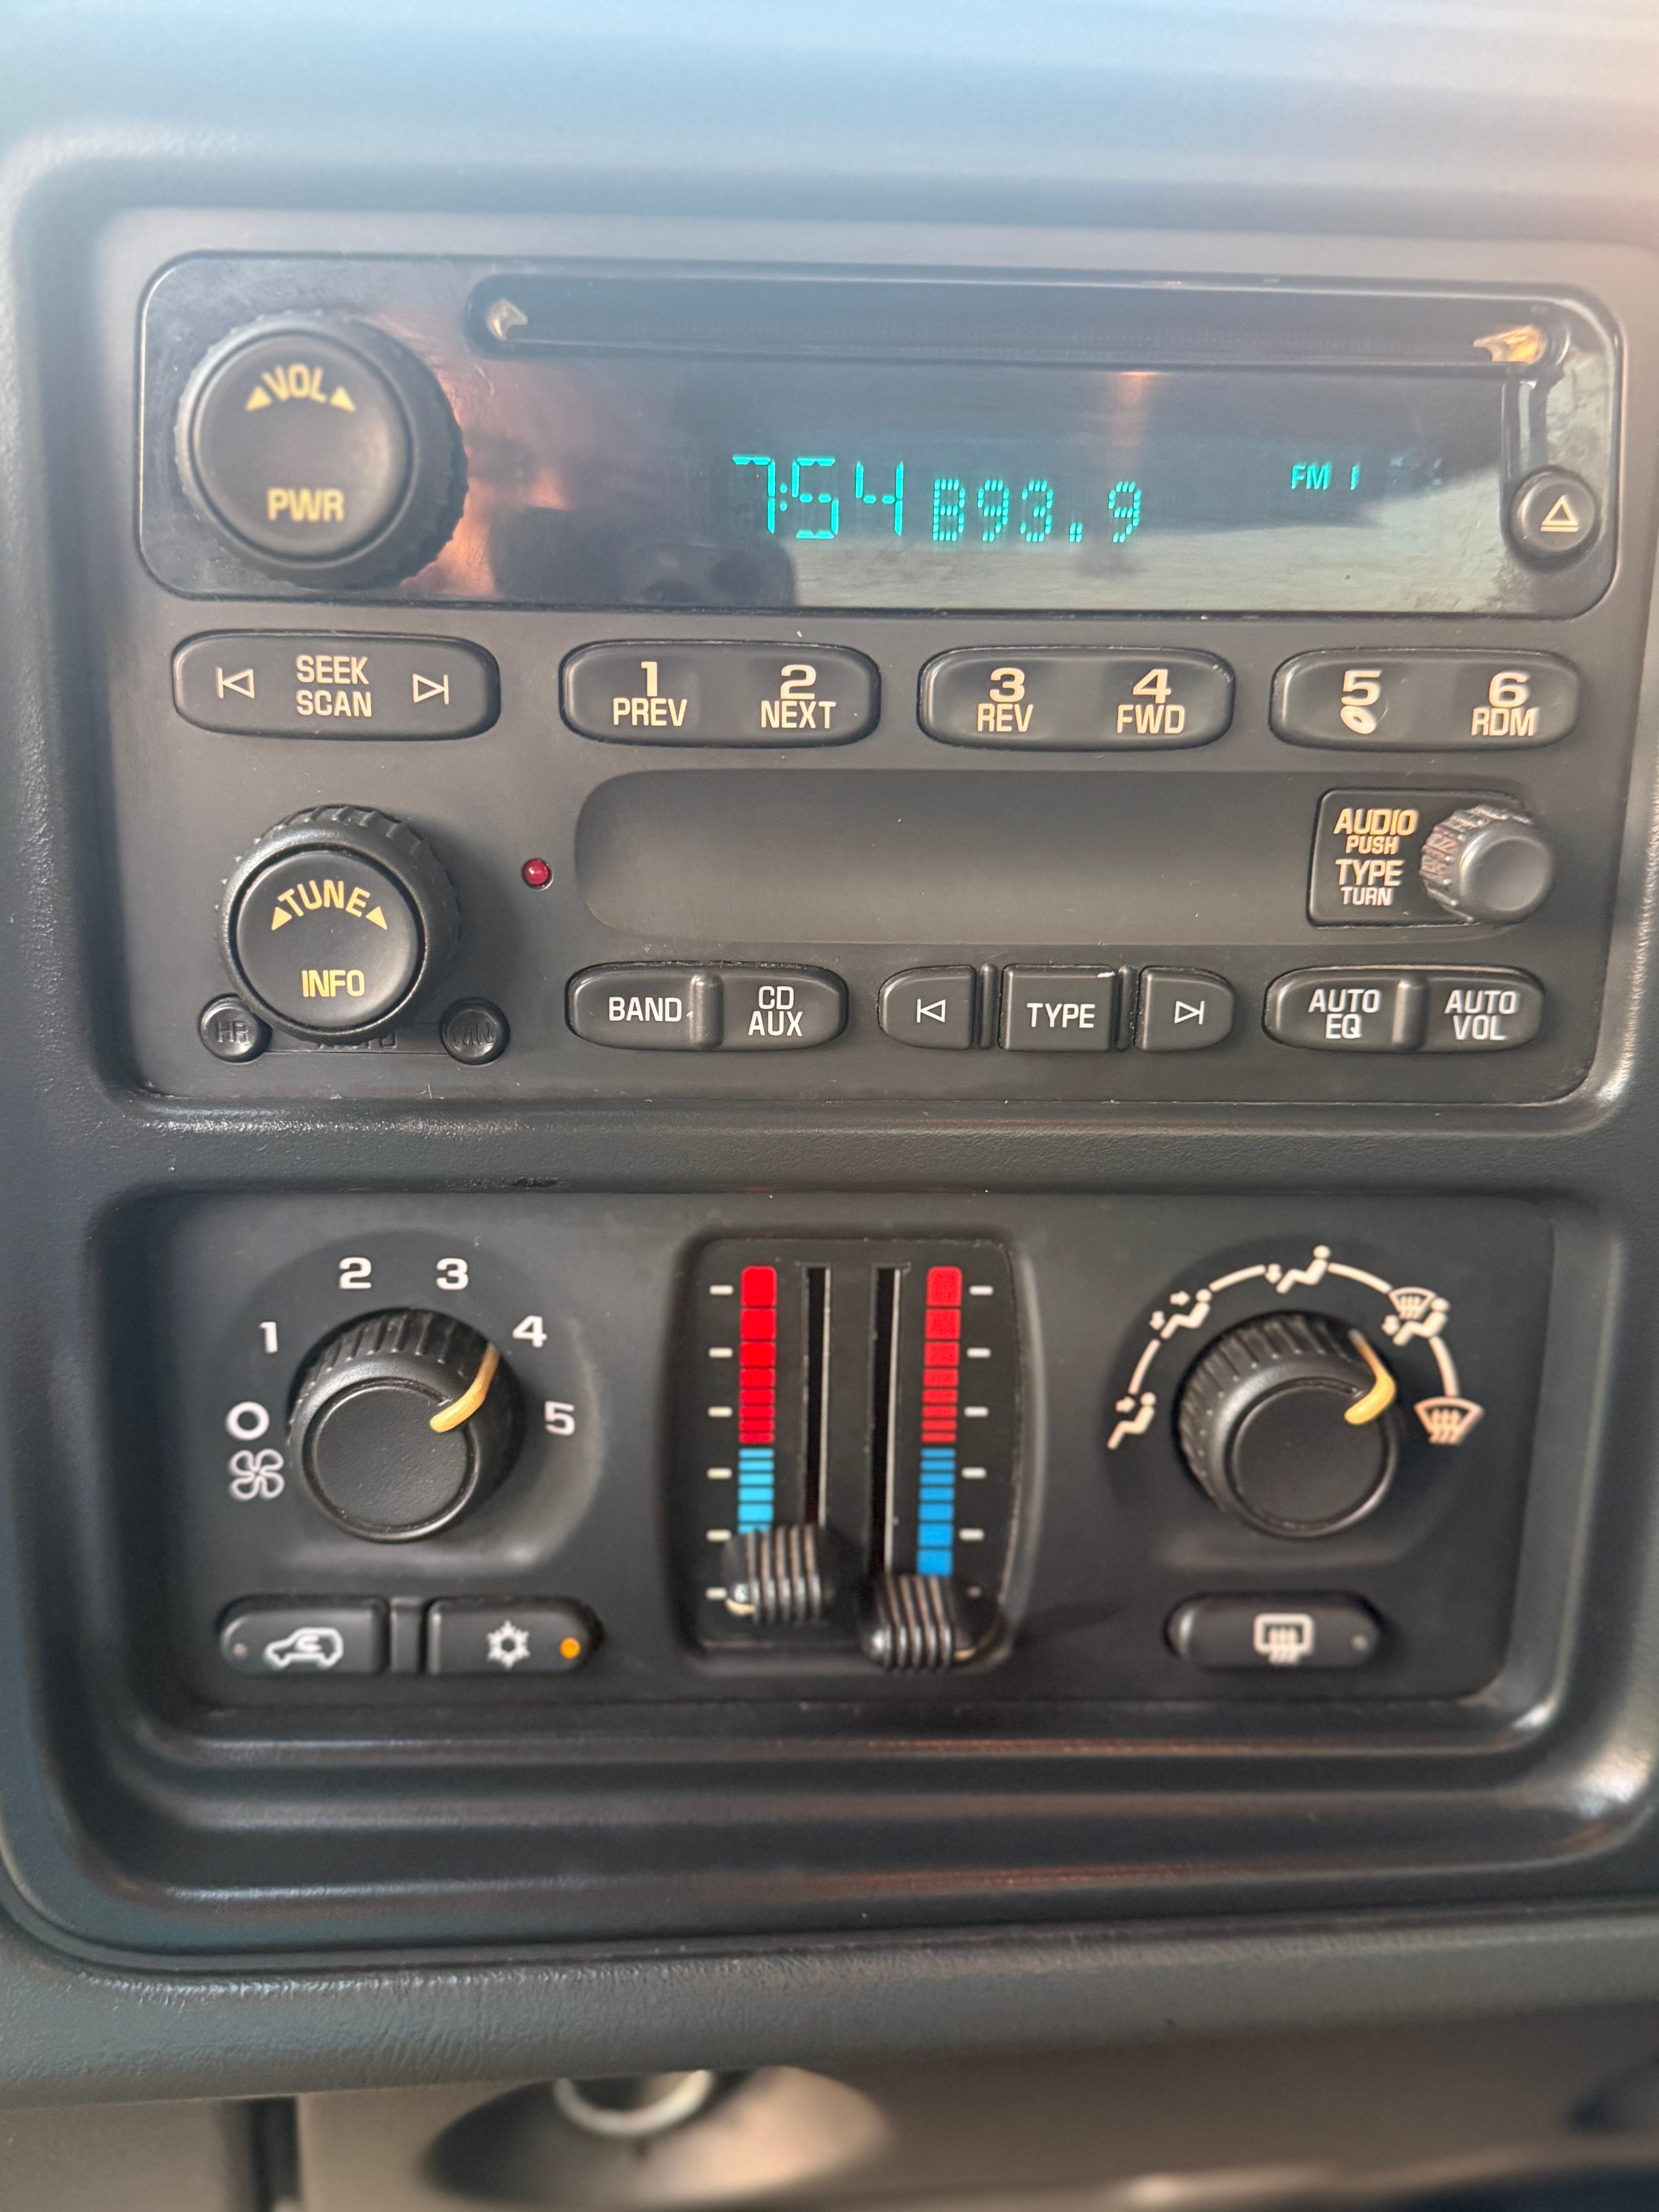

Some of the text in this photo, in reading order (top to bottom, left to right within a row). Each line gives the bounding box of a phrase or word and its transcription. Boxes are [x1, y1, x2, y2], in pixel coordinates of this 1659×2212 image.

[262, 364, 327, 404] VOL
[1291, 462, 1331, 489] FM
[268, 488, 345, 522] PWR
[732, 454, 903, 539] 7:54
[296, 655, 369, 684] SEEK
[641, 661, 658, 697] 1
[780, 665, 817, 700] 2
[989, 668, 1025, 702] 3
[1132, 669, 1171, 704] 4
[1341, 670, 1382, 706] 5
[1489, 672, 1530, 708] 6
[296, 690, 372, 717] SCAN
[613, 698, 687, 726] PREV
[761, 701, 836, 728] NEXT
[977, 704, 1033, 732] REV
[1116, 704, 1185, 734] FWD
[1472, 707, 1539, 736] RDM
[1333, 808, 1419, 836] AUDIO
[1346, 836, 1399, 855] PUSH
[1335, 859, 1404, 886] TYPE
[278, 880, 370, 917] TUNE
[1341, 887, 1393, 906] TURN
[301, 970, 365, 997] INFO
[609, 997, 682, 1022] BAND
[758, 986, 794, 1010] CD
[1308, 989, 1382, 1013] AUTO
[1444, 990, 1519, 1014] AUTO
[748, 1011, 803, 1037] AUX
[1027, 1003, 1095, 1028] TYPE
[1326, 1013, 1362, 1039] EQ
[1453, 1015, 1507, 1041] VOL
[217, 1021, 250, 1045] HR
[451, 1022, 495, 1047] MIN
[339, 1257, 372, 1290] 2
[436, 1258, 469, 1290] 3
[259, 1321, 278, 1353] 1
[512, 1316, 547, 1347] 4
[545, 1401, 575, 1436] 5
